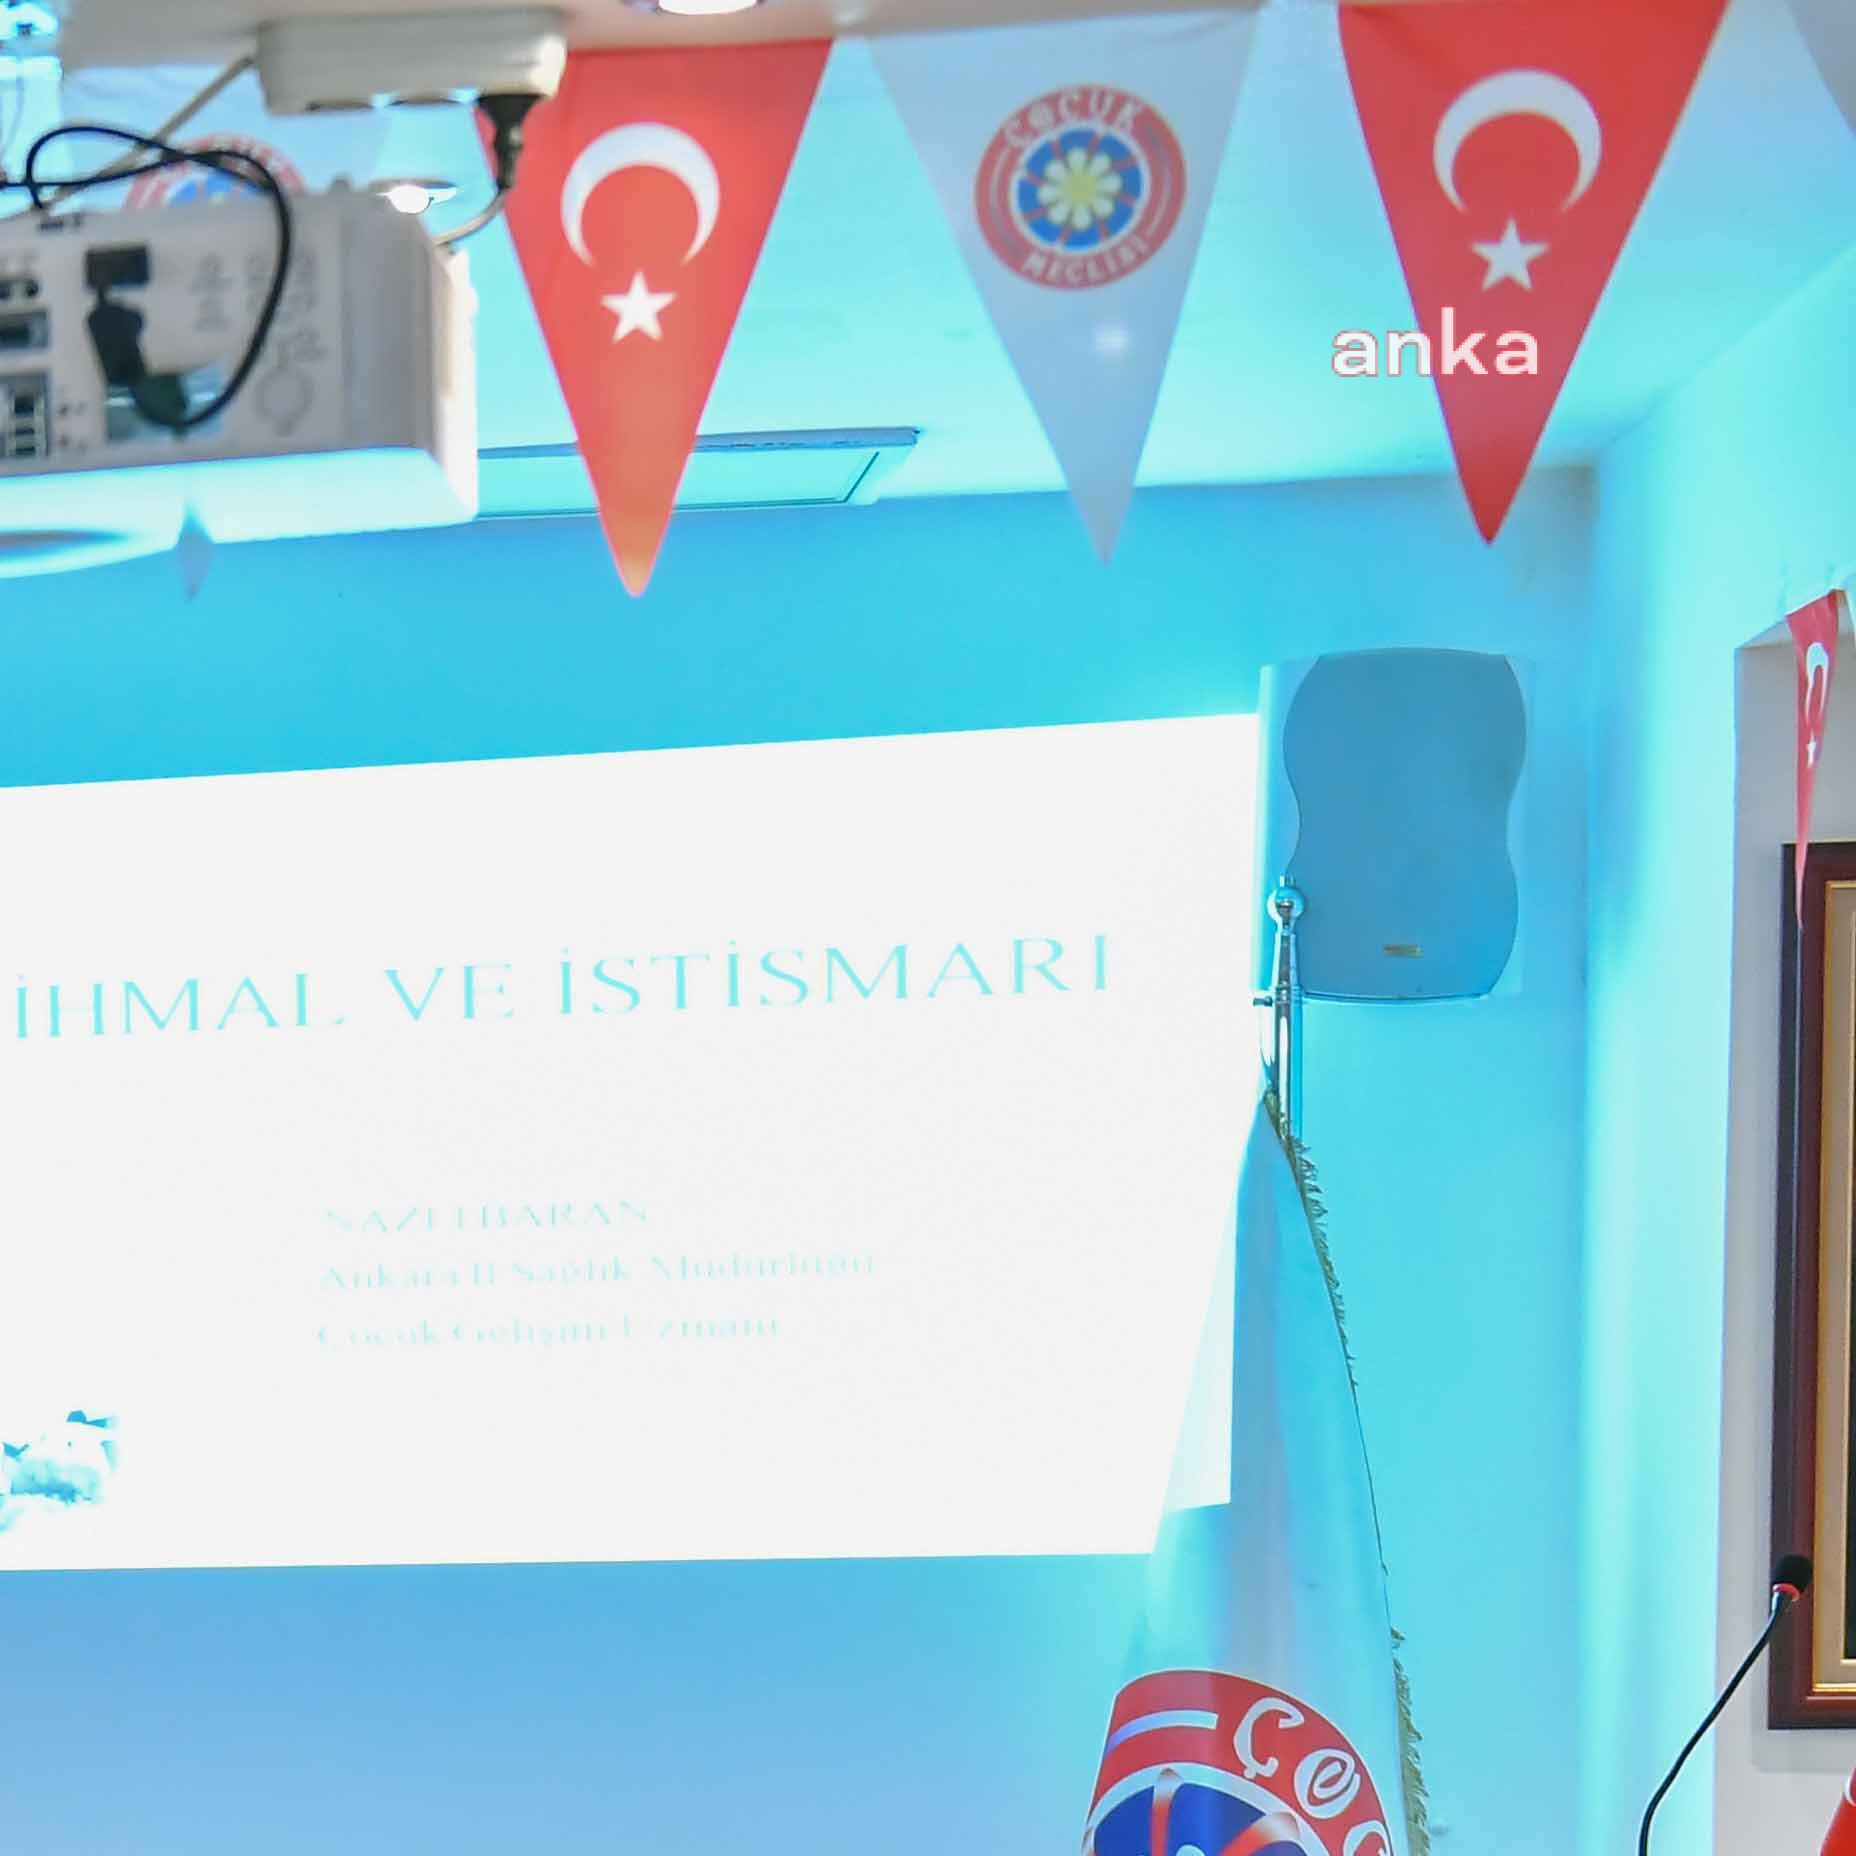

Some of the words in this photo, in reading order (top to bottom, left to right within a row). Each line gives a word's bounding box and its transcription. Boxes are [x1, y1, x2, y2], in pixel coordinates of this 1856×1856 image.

[15, 972, 347, 1040] İHMAL
[384, 960, 515, 1022] VE
[559, 931, 1111, 1017] İSTİSMARI
